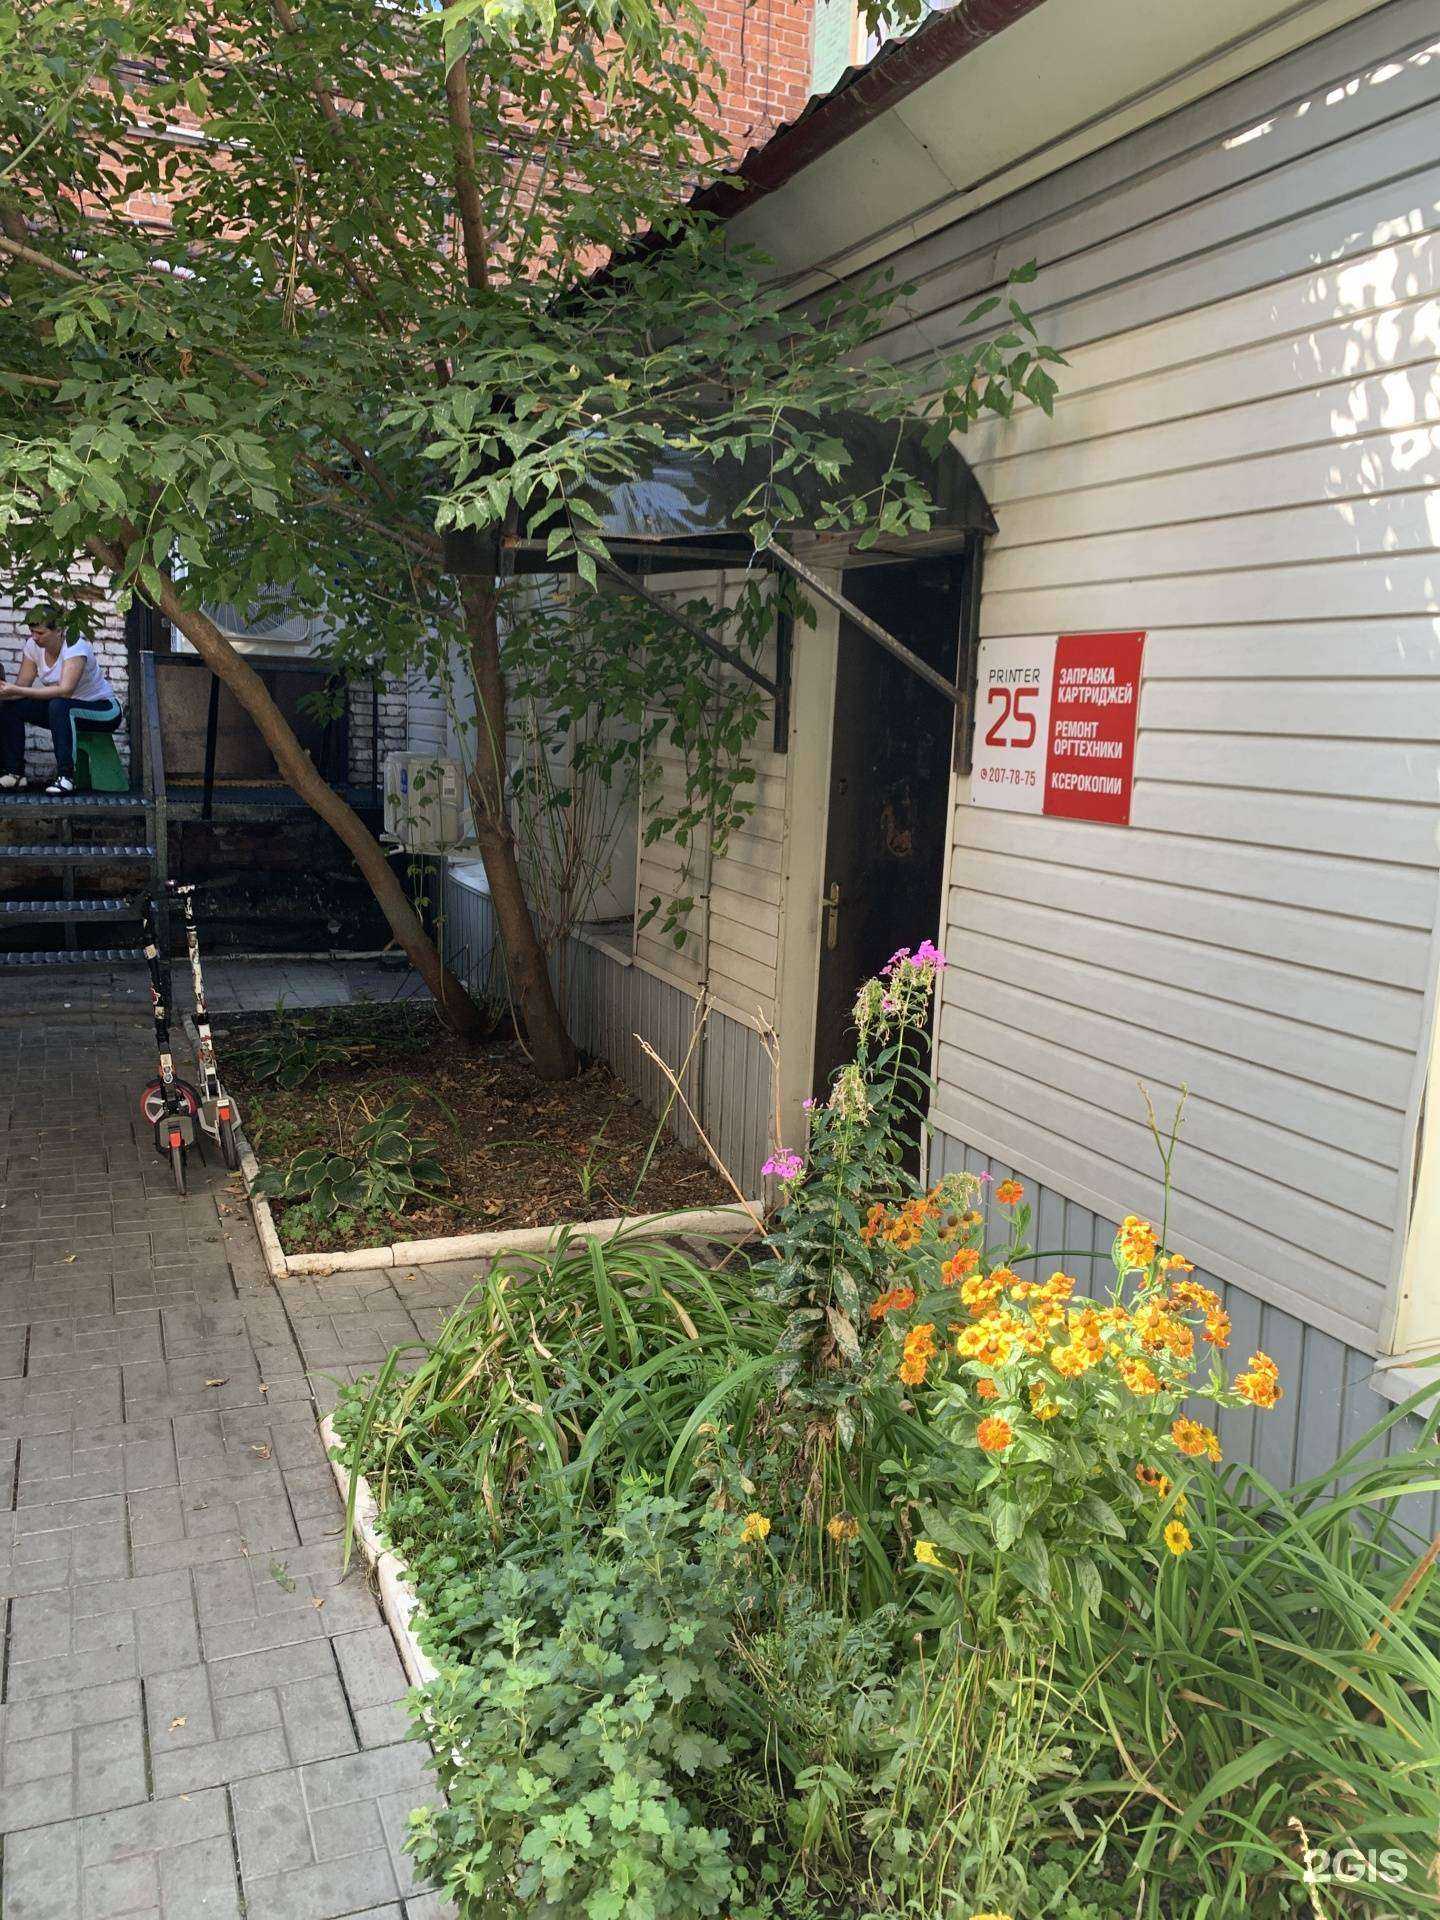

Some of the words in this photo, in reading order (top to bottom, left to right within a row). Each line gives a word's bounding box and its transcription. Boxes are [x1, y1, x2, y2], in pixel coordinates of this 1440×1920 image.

[989, 668, 1040, 683] PRINTER
[1059, 667, 1115, 685] ЗАПРАВКА
[1058, 683, 1133, 706] КАРТРИДЖЕЙ
[985, 687, 1039, 748] 25
[1055, 720, 1099, 737] РЕМОНТ
[1054, 739, 1123, 759] ОРГТЕХНИКИ
[989, 768, 1036, 786] 207-78-75
[1052, 772, 1122, 795] КСЕРОКОПИИ
